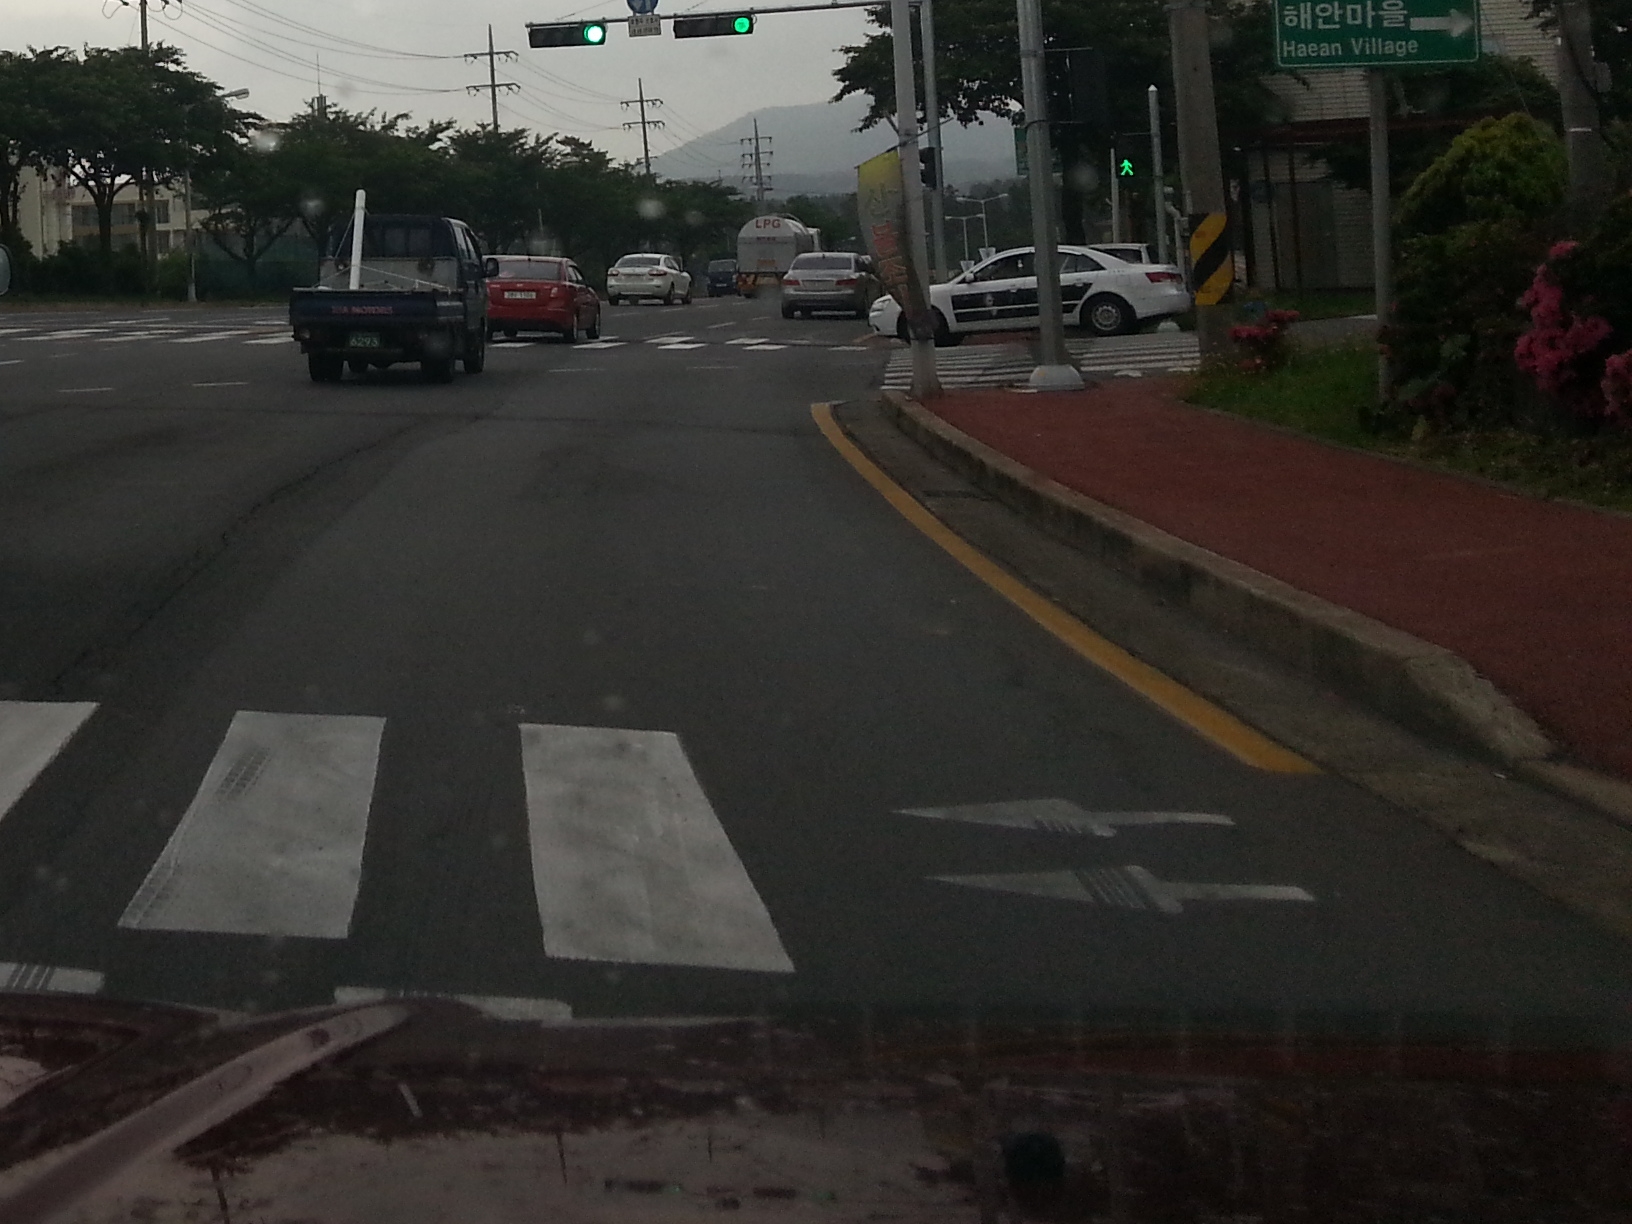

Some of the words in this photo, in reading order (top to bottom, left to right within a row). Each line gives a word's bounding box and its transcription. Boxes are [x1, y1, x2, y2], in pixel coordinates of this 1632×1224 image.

[1283, 0, 1408, 30] 해안마을
[1283, 39, 1343, 57] Haean
[1350, 37, 1419, 57] Village
[755, 218, 781, 229] LPG
